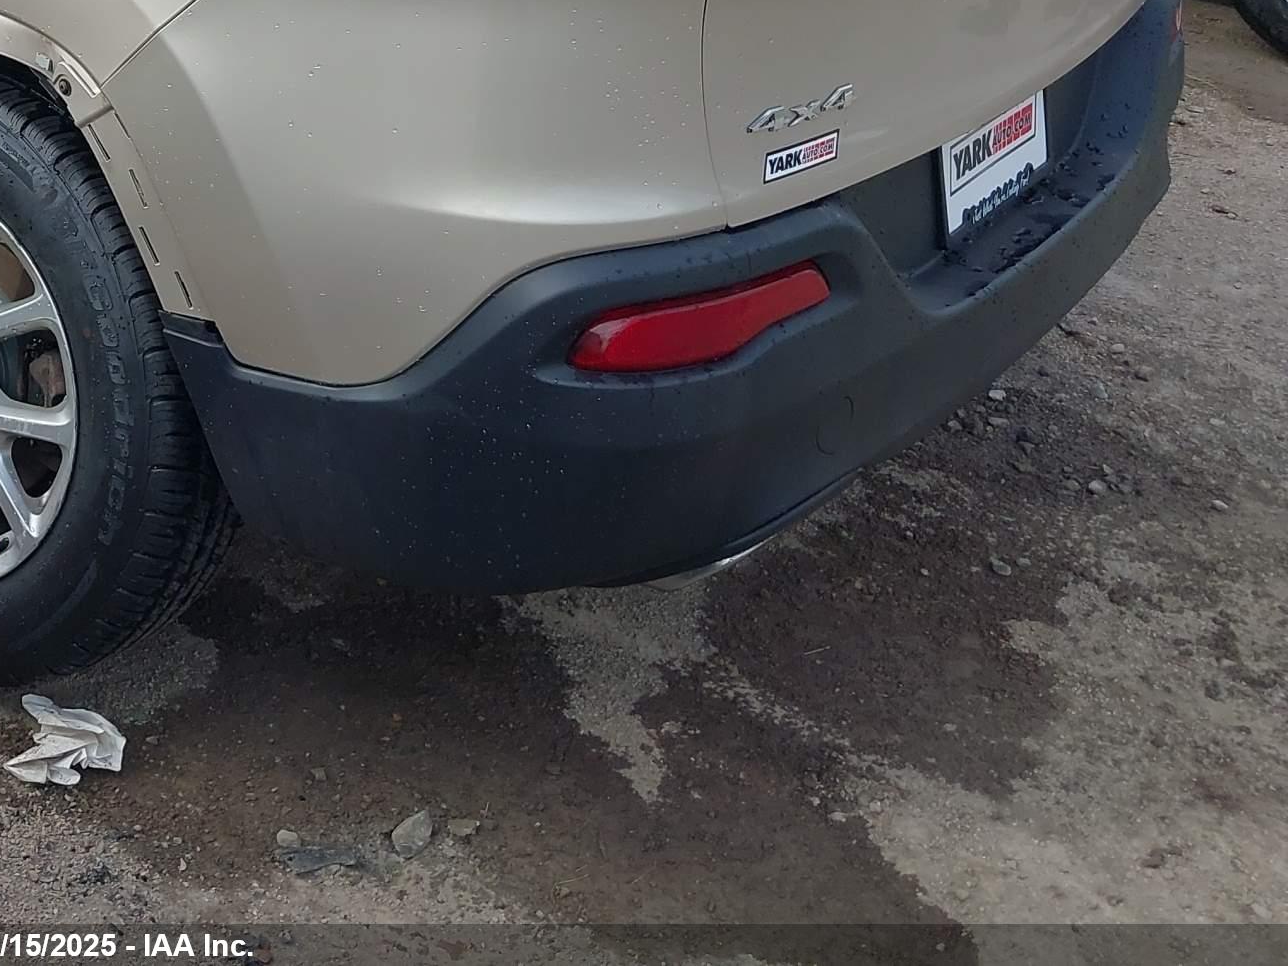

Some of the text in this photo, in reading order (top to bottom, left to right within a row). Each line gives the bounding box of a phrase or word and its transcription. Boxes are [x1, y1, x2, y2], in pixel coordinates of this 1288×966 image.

[746, 83, 856, 134] 4x4
[768, 147, 803, 175] YARK
[953, 127, 993, 181] YARK
